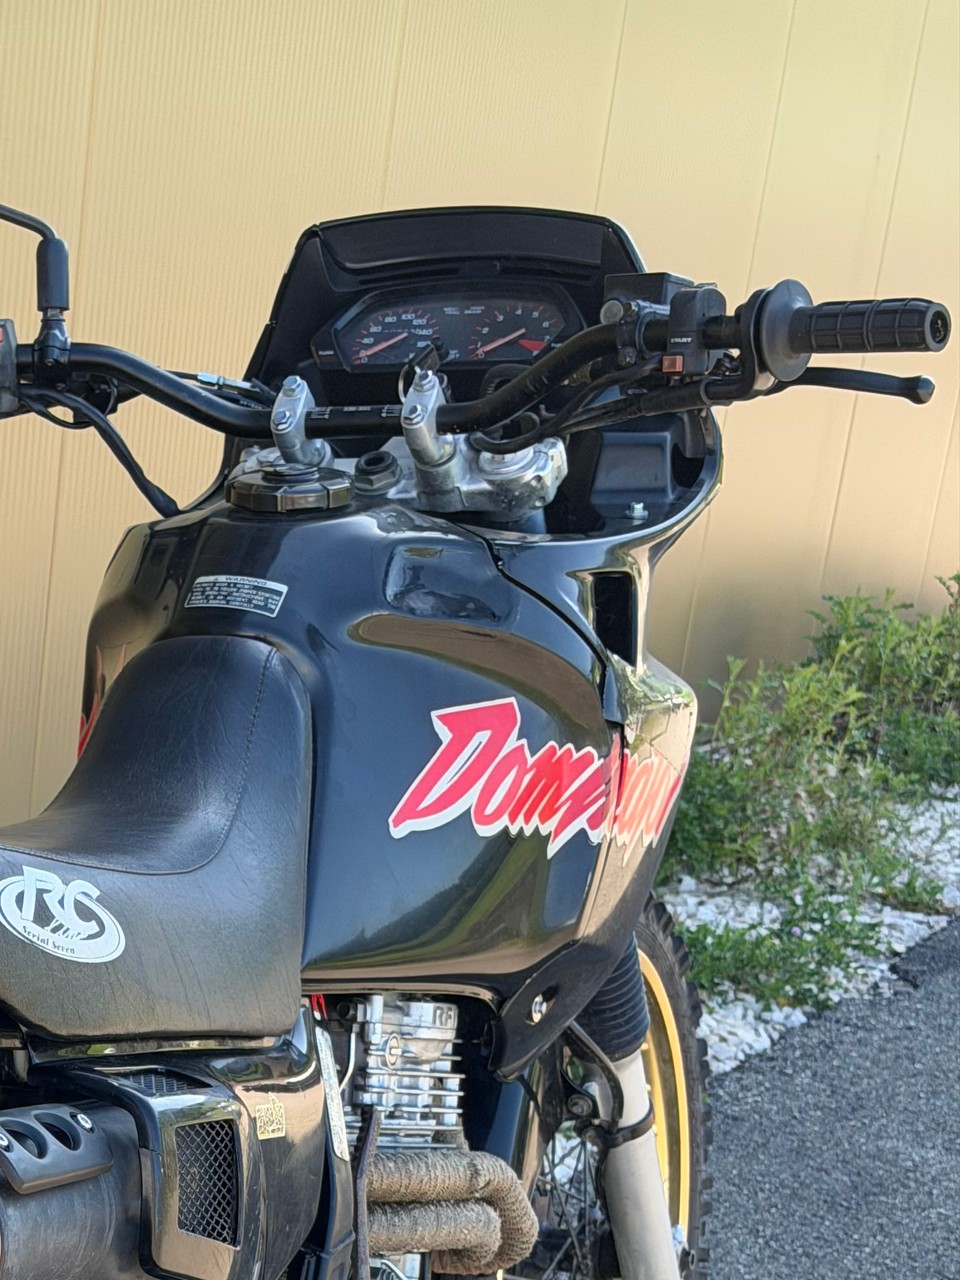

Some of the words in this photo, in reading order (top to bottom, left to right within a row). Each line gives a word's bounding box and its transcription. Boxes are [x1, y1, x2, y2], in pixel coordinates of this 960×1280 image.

[225, 577, 267, 586] WARNING
[22, 925, 50, 946] Serial
[51, 940, 76, 954] Seven
